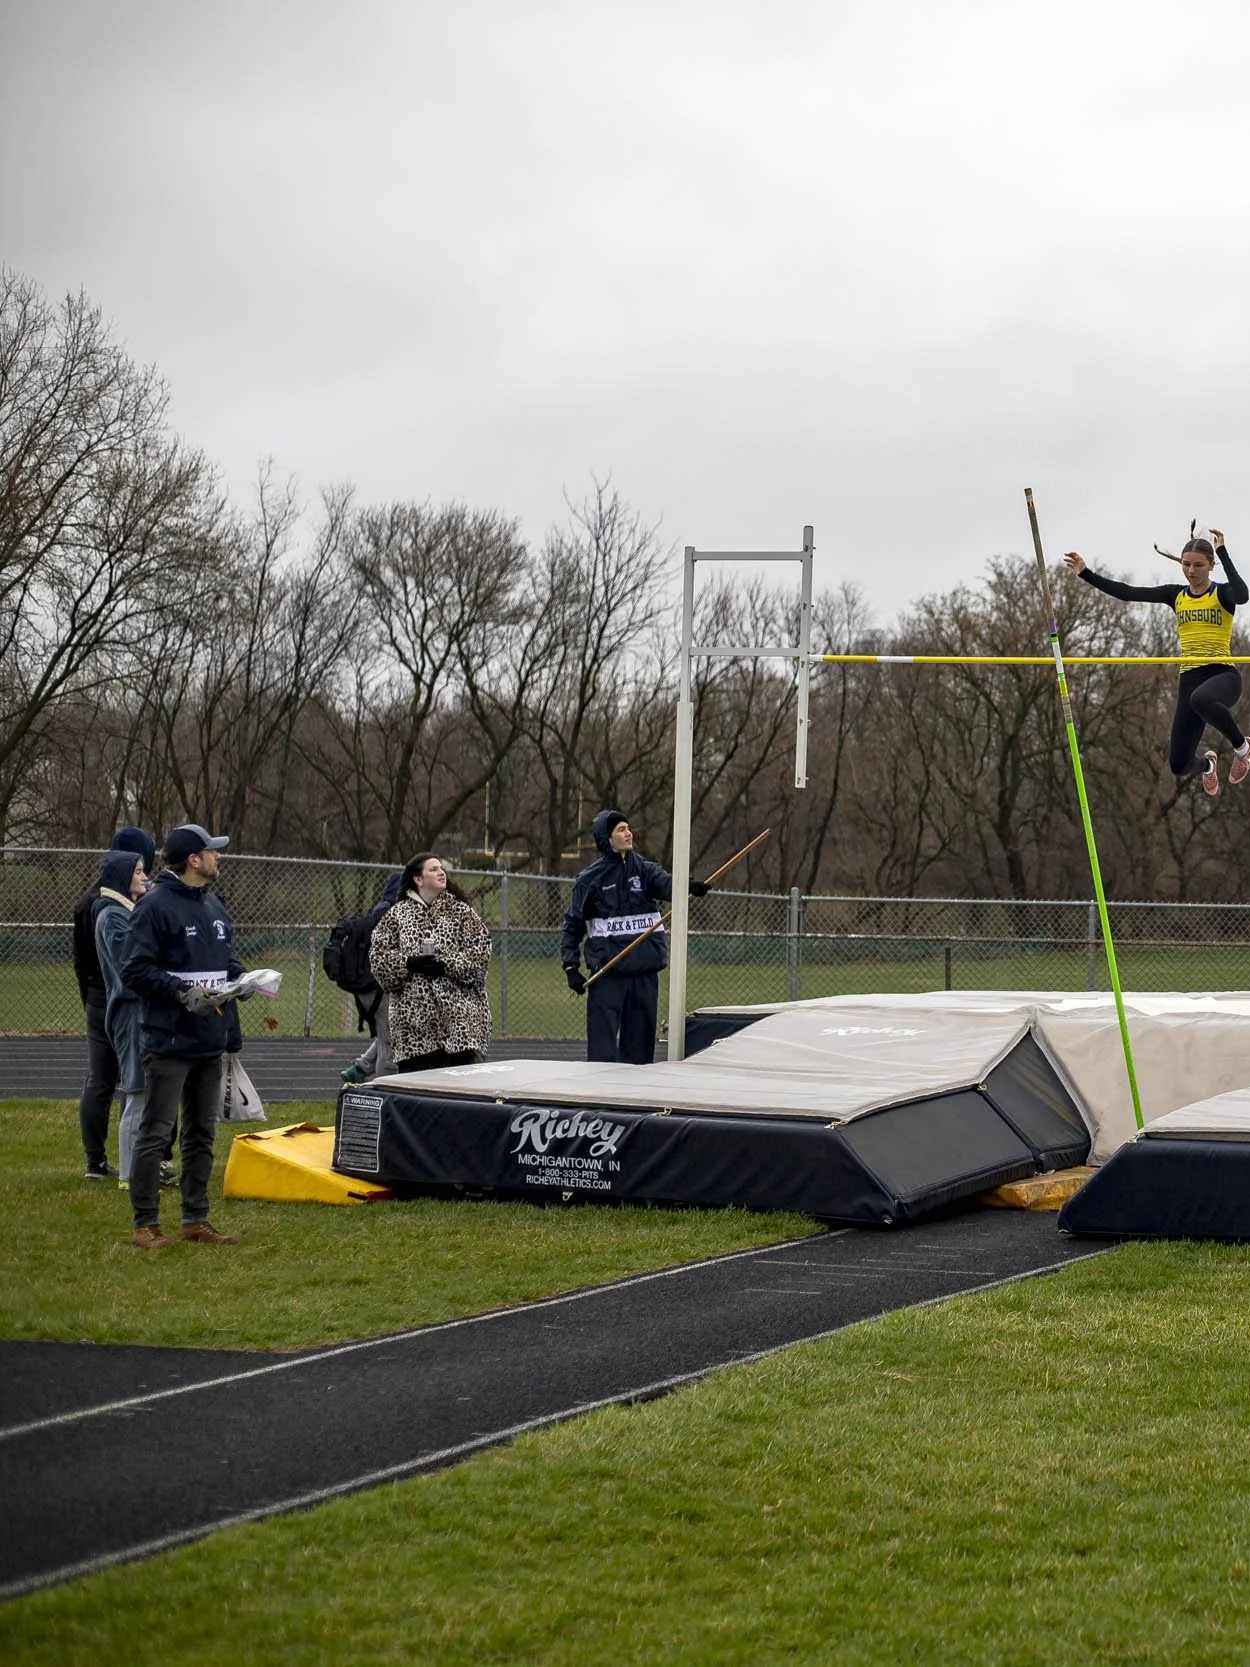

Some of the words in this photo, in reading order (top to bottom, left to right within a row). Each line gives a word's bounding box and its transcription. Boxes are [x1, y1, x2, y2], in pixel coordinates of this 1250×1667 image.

[1177, 608, 1222, 626] HNSBURG
[606, 920, 624, 932] RACK
[350, 1097, 380, 1107] WARNING
[510, 1109, 625, 1157] Richey
[518, 1154, 604, 1172] MICHIGANTOWN,
[609, 1160, 621, 1171] IN
[538, 1168, 599, 1179] 1-800-333-PITS
[526, 1174, 612, 1190] RICHEYATHLETICS.COM
